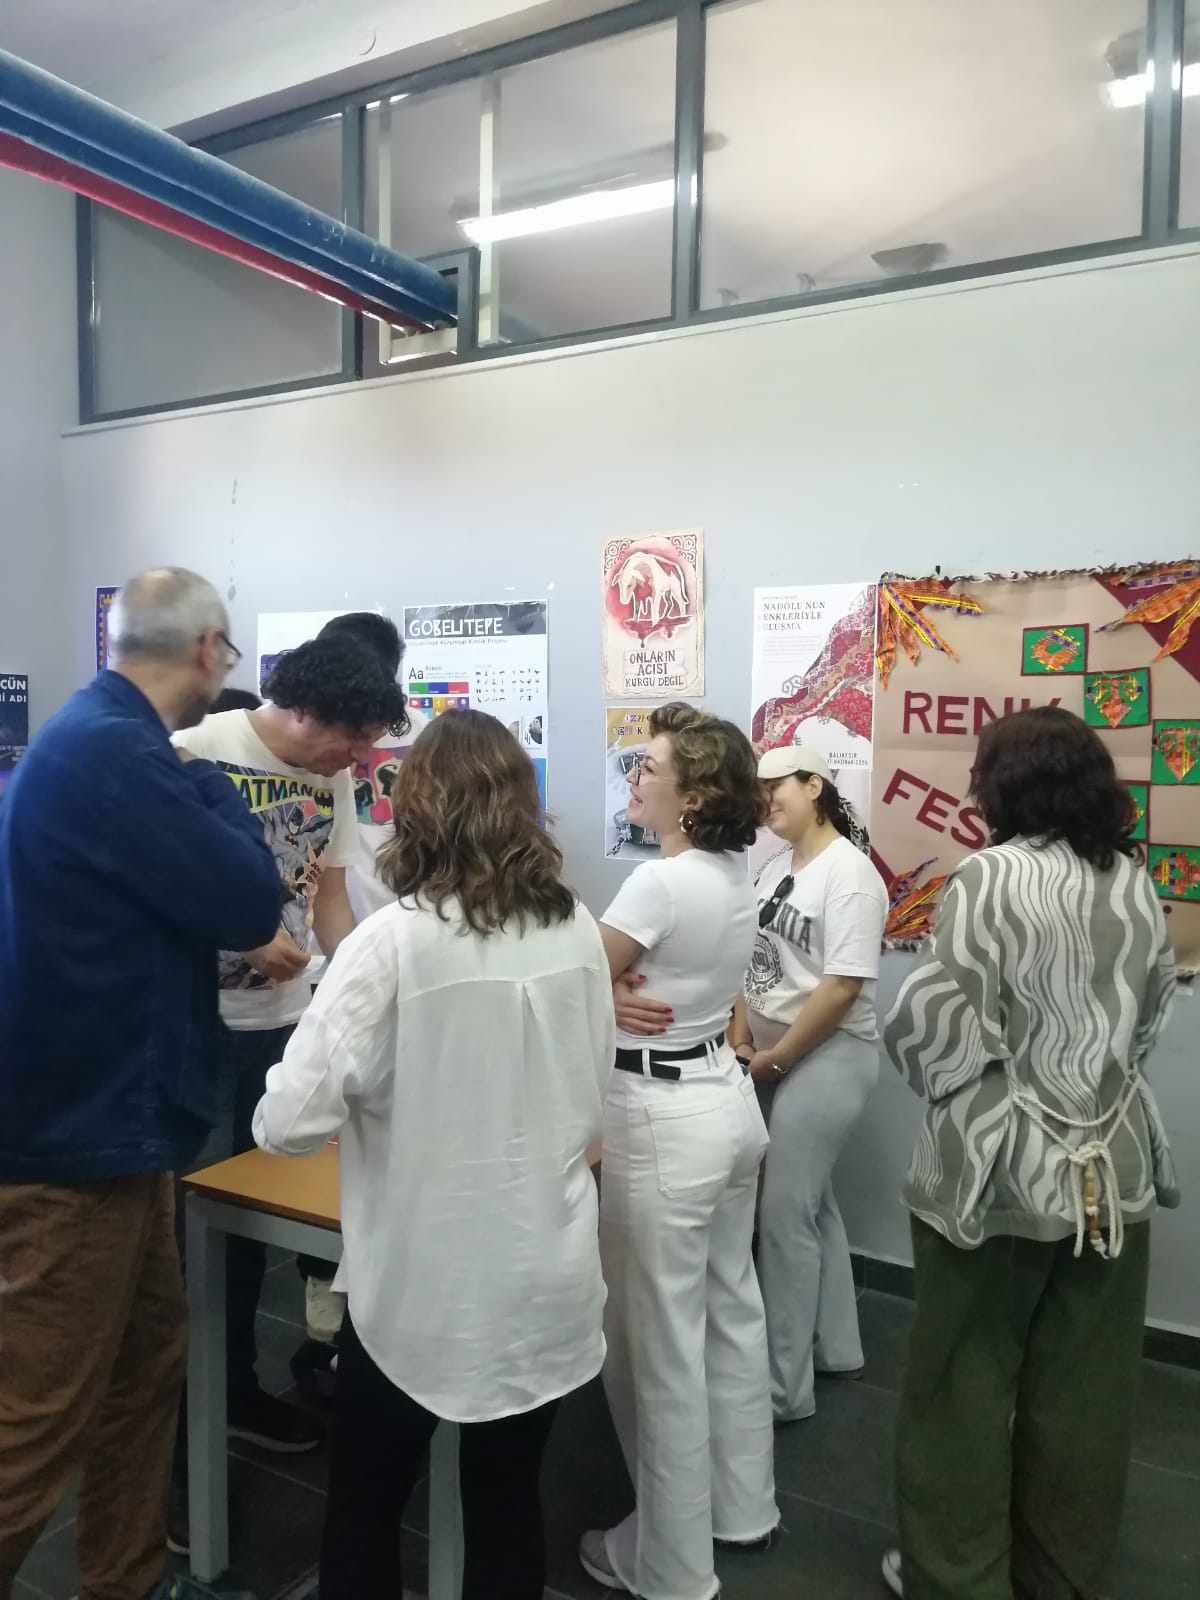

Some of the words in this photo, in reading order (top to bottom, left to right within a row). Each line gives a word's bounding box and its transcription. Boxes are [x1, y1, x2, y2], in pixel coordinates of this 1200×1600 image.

[629, 650, 675, 664] ONLARIN
[408, 667, 424, 680] Aa
[637, 663, 667, 676] ACISI
[626, 677, 655, 687] KURGU
[658, 675, 684, 686] DEĞİL
[9, 694, 26, 702] ADI
[903, 690, 1062, 736] REN
[240, 778, 313, 808] ATMAN
